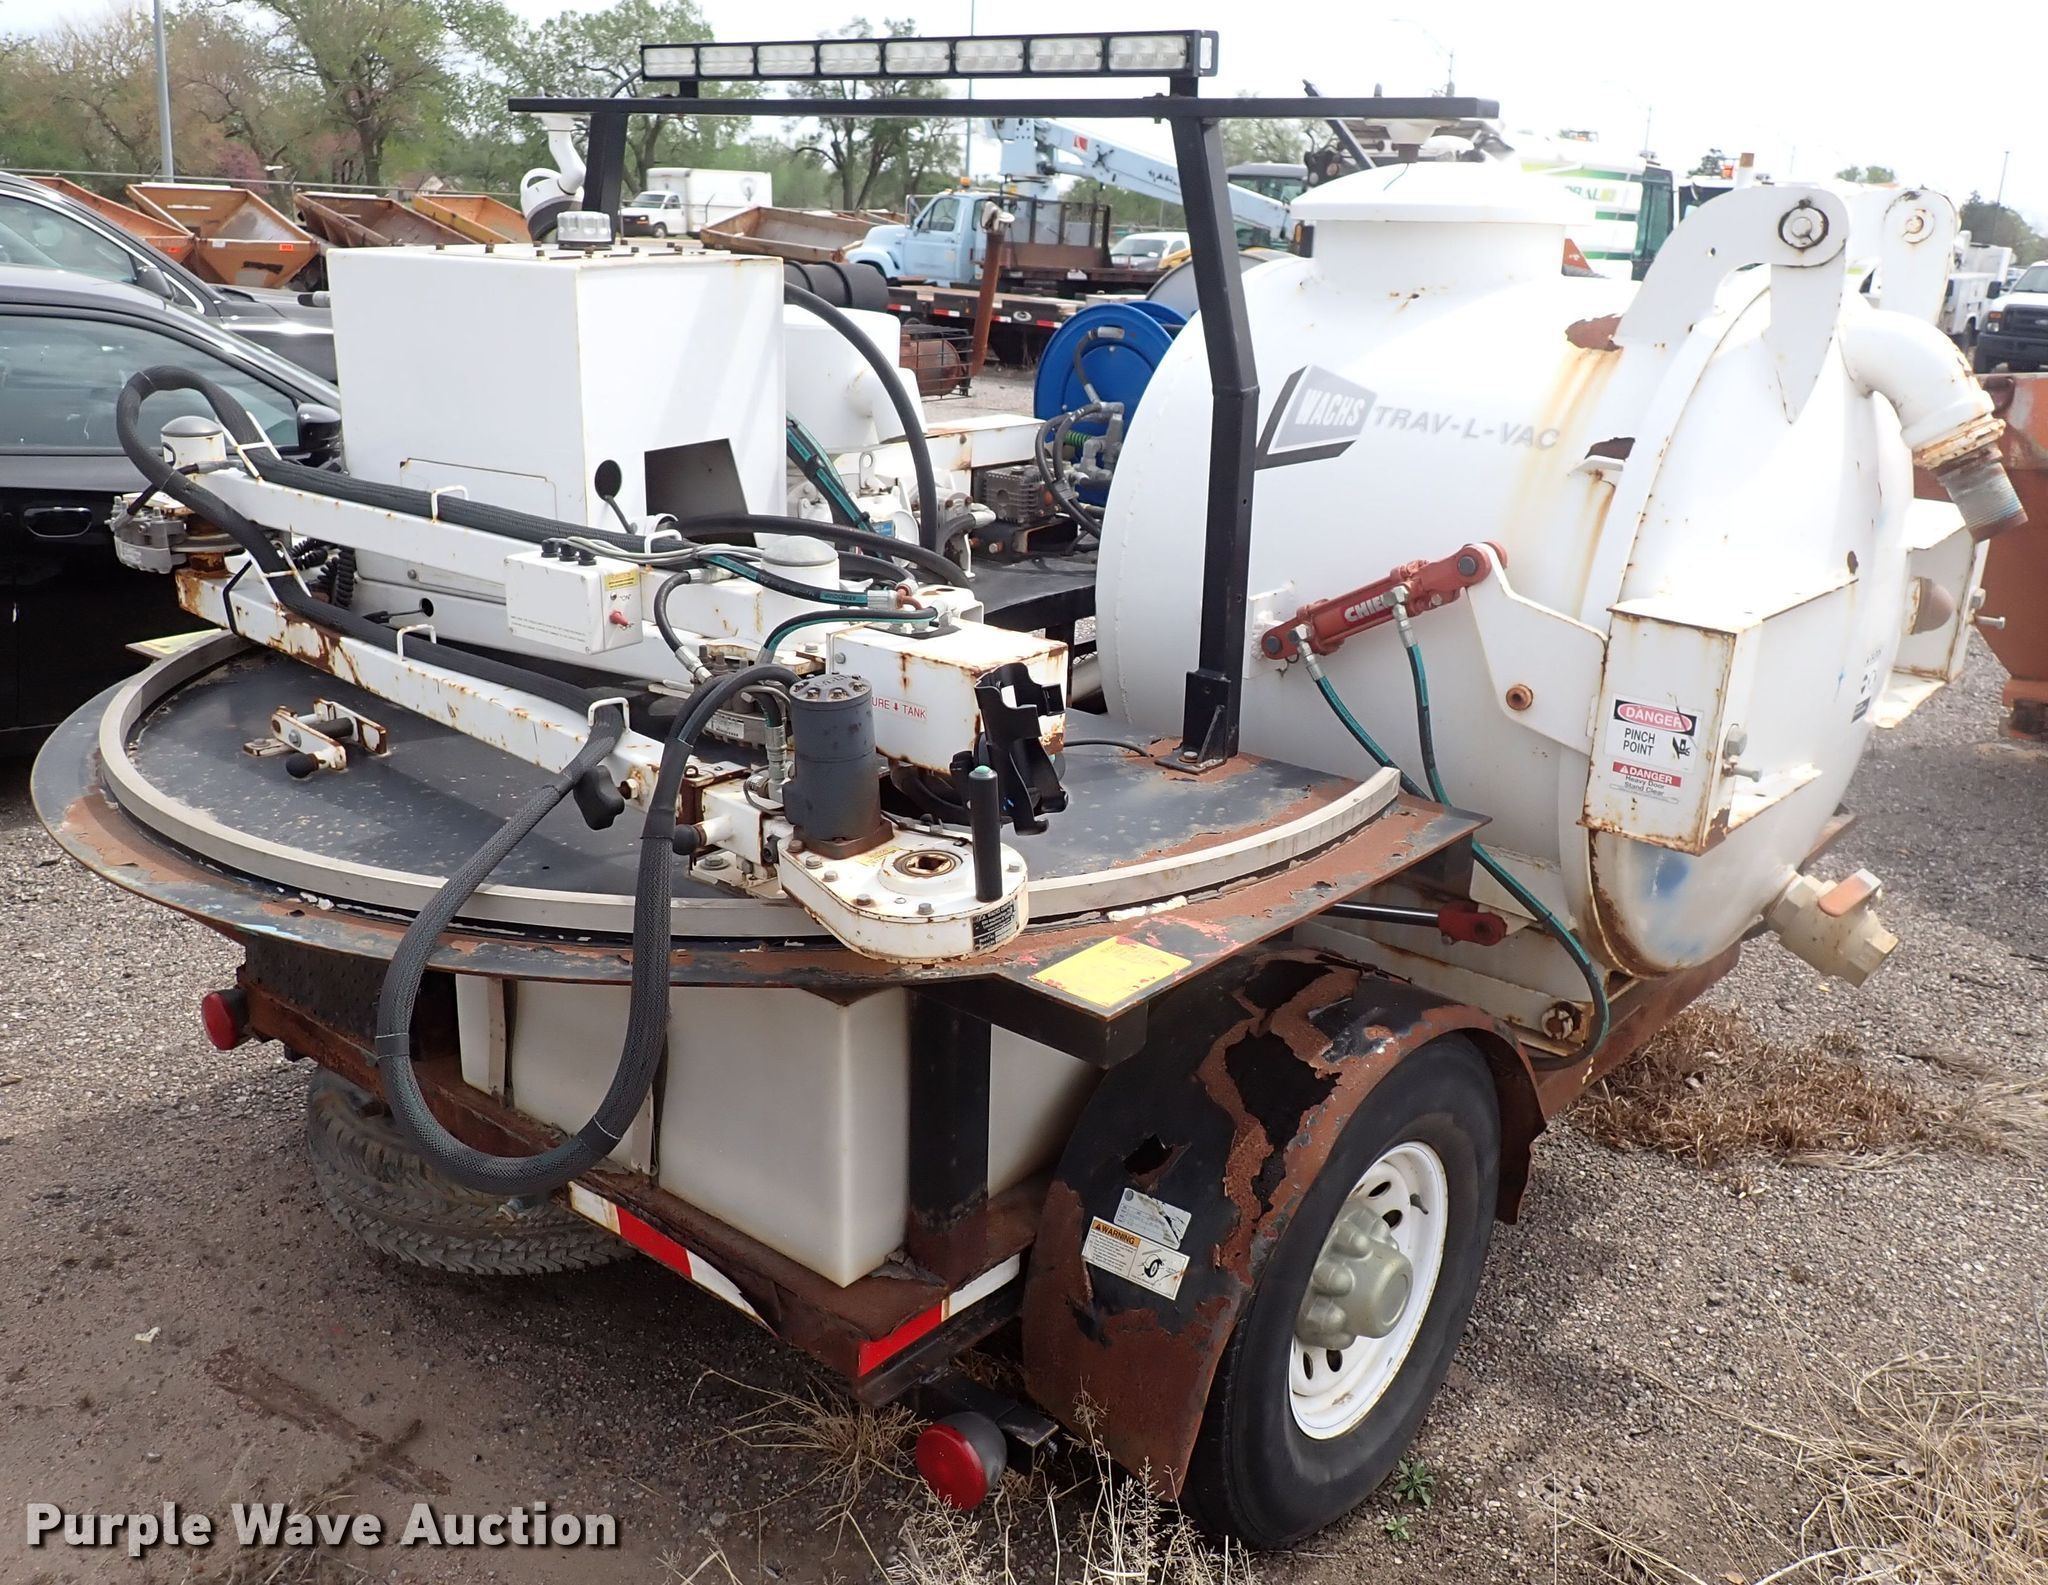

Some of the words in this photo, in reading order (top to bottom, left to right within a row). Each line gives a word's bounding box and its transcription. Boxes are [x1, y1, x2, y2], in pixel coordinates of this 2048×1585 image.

[1295, 388, 1366, 427] WACHS
[1373, 405, 1561, 450] TRAV-L-VAC
[1344, 593, 1392, 623] CHIE
[872, 696, 890, 711] URE
[902, 704, 927, 720] TANK
[1625, 706, 1683, 729] DANGER
[1624, 727, 1656, 745] PINCH
[1623, 740, 1654, 756] POINT
[1629, 767, 1673, 784] DANGER
[1102, 1224, 1135, 1245] WARNING
